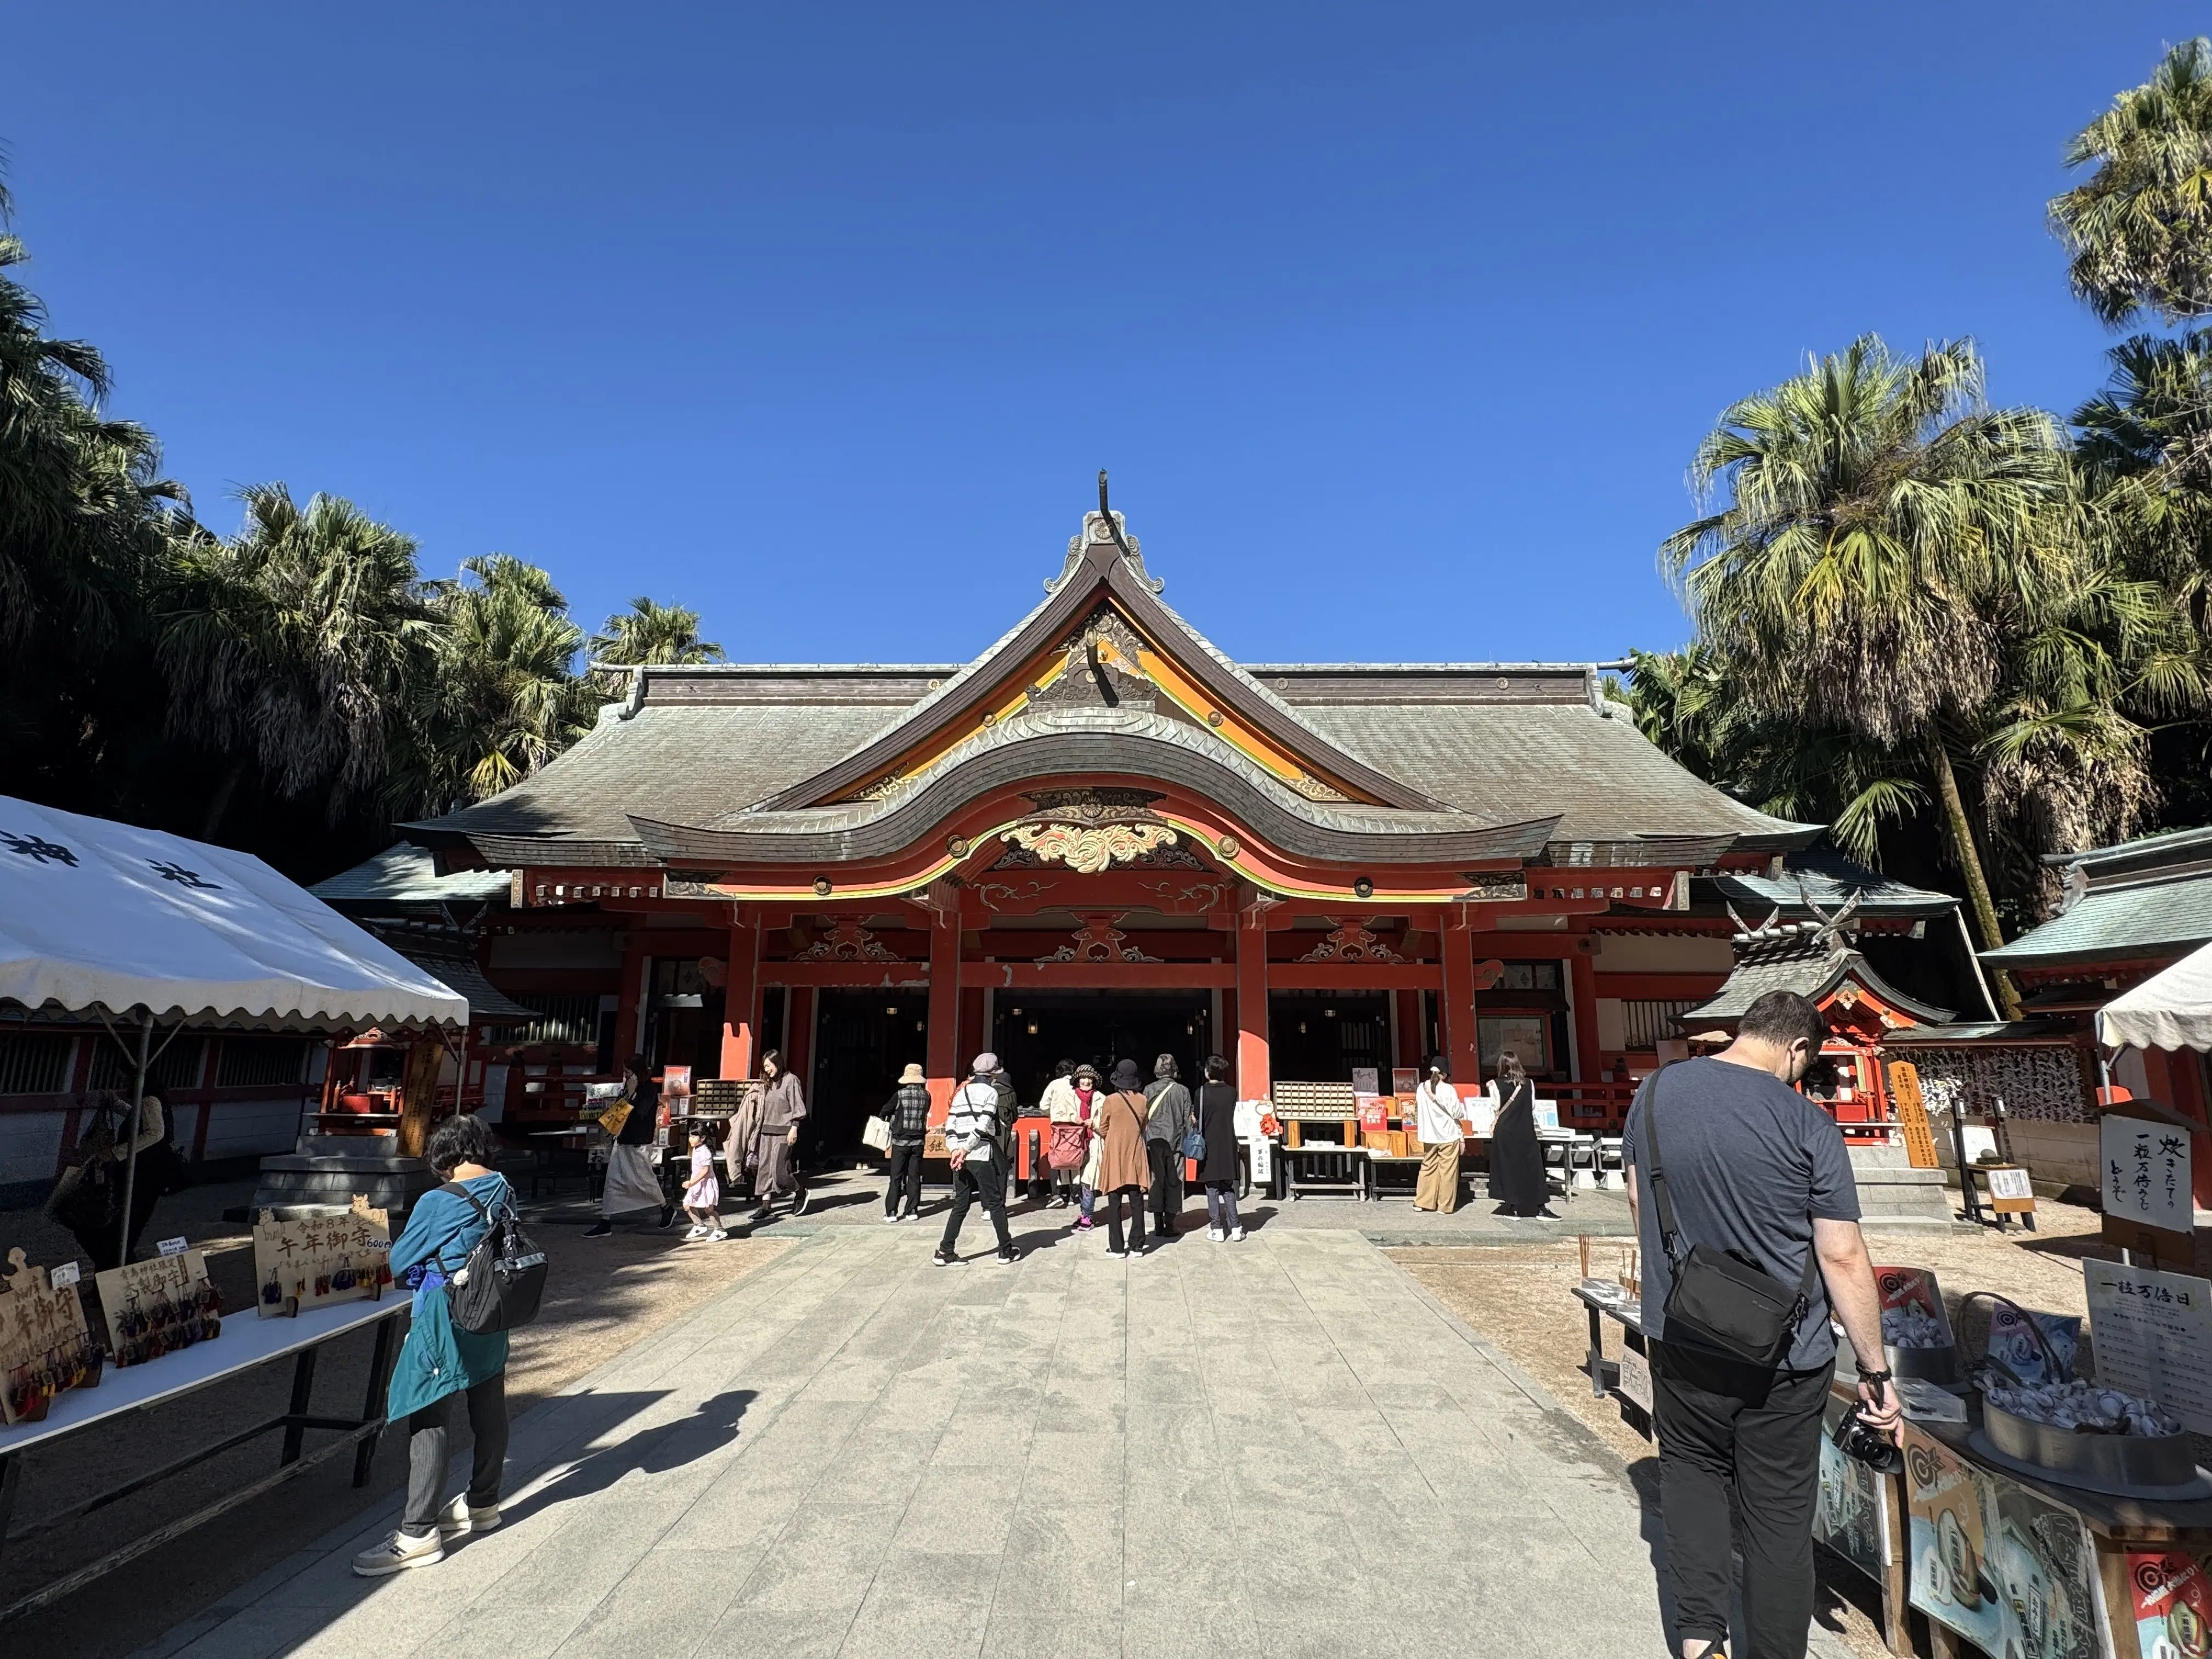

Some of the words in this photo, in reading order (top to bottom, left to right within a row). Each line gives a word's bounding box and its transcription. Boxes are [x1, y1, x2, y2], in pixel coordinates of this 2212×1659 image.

[2157, 1133, 2186, 1209] 炊きたての
[295, 1216, 349, 1233] 令和8年
[275, 1226, 371, 1258] 午年御守
[2100, 1279, 2191, 1307] 一粒万倍日
